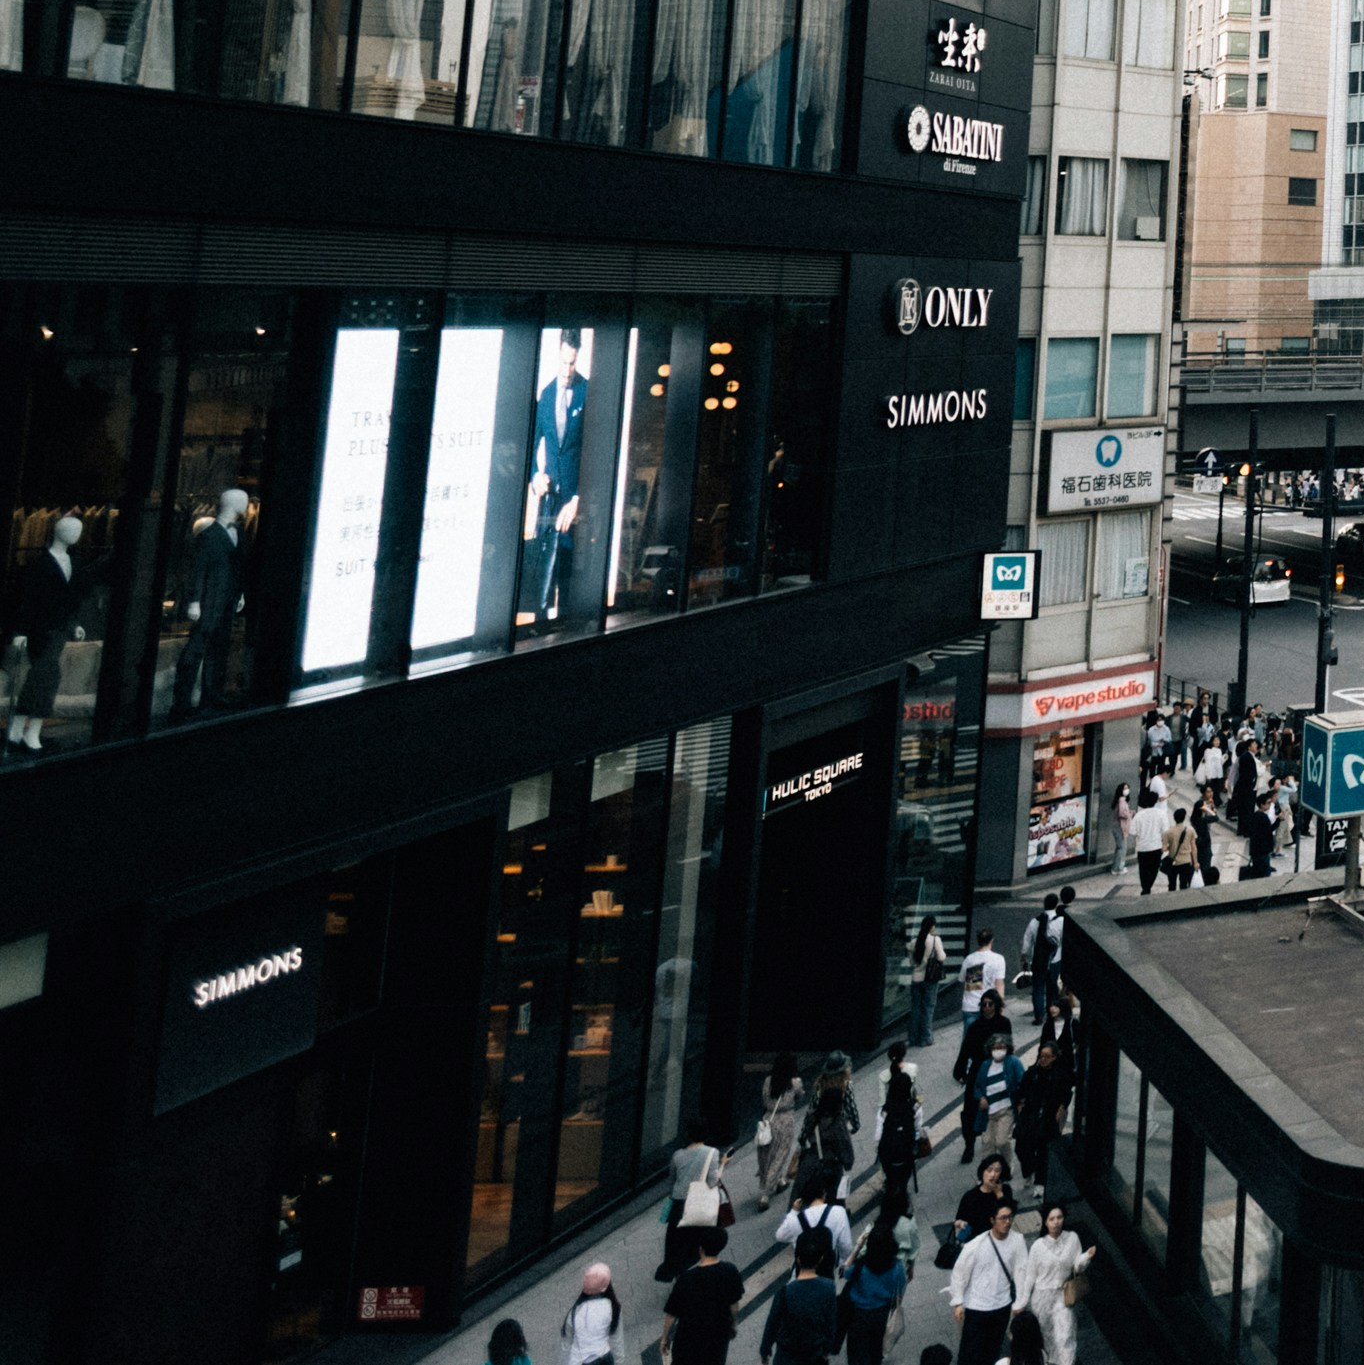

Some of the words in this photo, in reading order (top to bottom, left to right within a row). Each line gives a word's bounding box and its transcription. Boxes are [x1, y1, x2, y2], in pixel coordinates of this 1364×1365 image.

[929, 71, 954, 87] ZARAI
[956, 79, 976, 92] OITA
[931, 111, 1004, 162] SABATINI
[943, 158, 951, 172] di
[951, 158, 977, 175] Firenze
[925, 286, 993, 328] ONLY
[887, 388, 988, 429] SIMMONS
[1061, 471, 1153, 495] 福石歯科医院
[1056, 692, 1096, 712] vape
[1096, 680, 1147, 703] studio
[772, 773, 811, 801] HULIC
[813, 753, 864, 785] SQUARE
[804, 782, 832, 802] TOKYO
[193, 946, 303, 1006] SIMMONS
